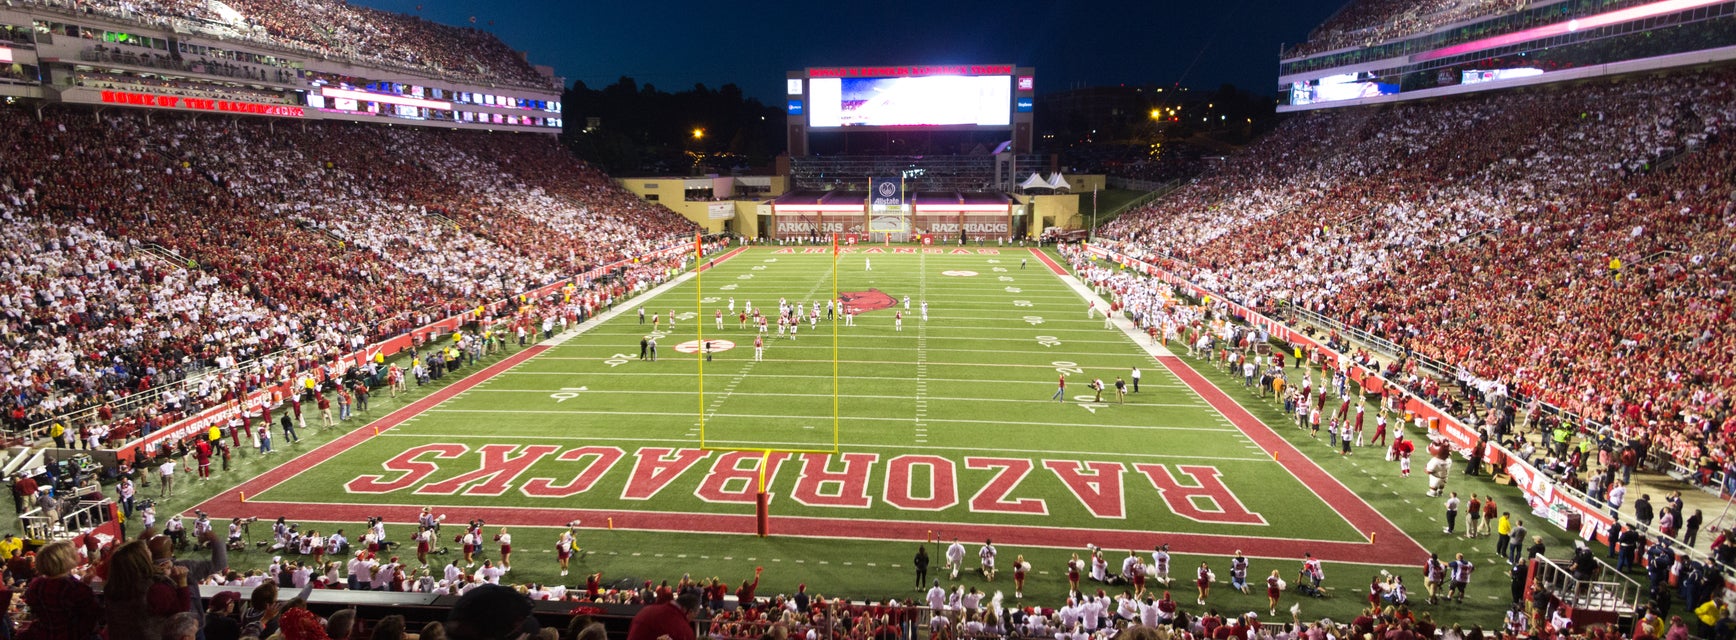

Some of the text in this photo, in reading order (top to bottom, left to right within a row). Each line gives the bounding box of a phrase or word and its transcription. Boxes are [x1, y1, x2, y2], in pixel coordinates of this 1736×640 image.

[972, 65, 1011, 75] STADIUM
[101, 90, 155, 106] HOME
[157, 95, 179, 107] OF
[183, 97, 215, 110] THE
[874, 197, 900, 206] Allstate
[777, 222, 844, 233] ARKANSAS
[931, 223, 1008, 233] RAZORBACKS
[1445, 423, 1470, 446] NISSAN
[343, 443, 1271, 527] RAZORBACKS
